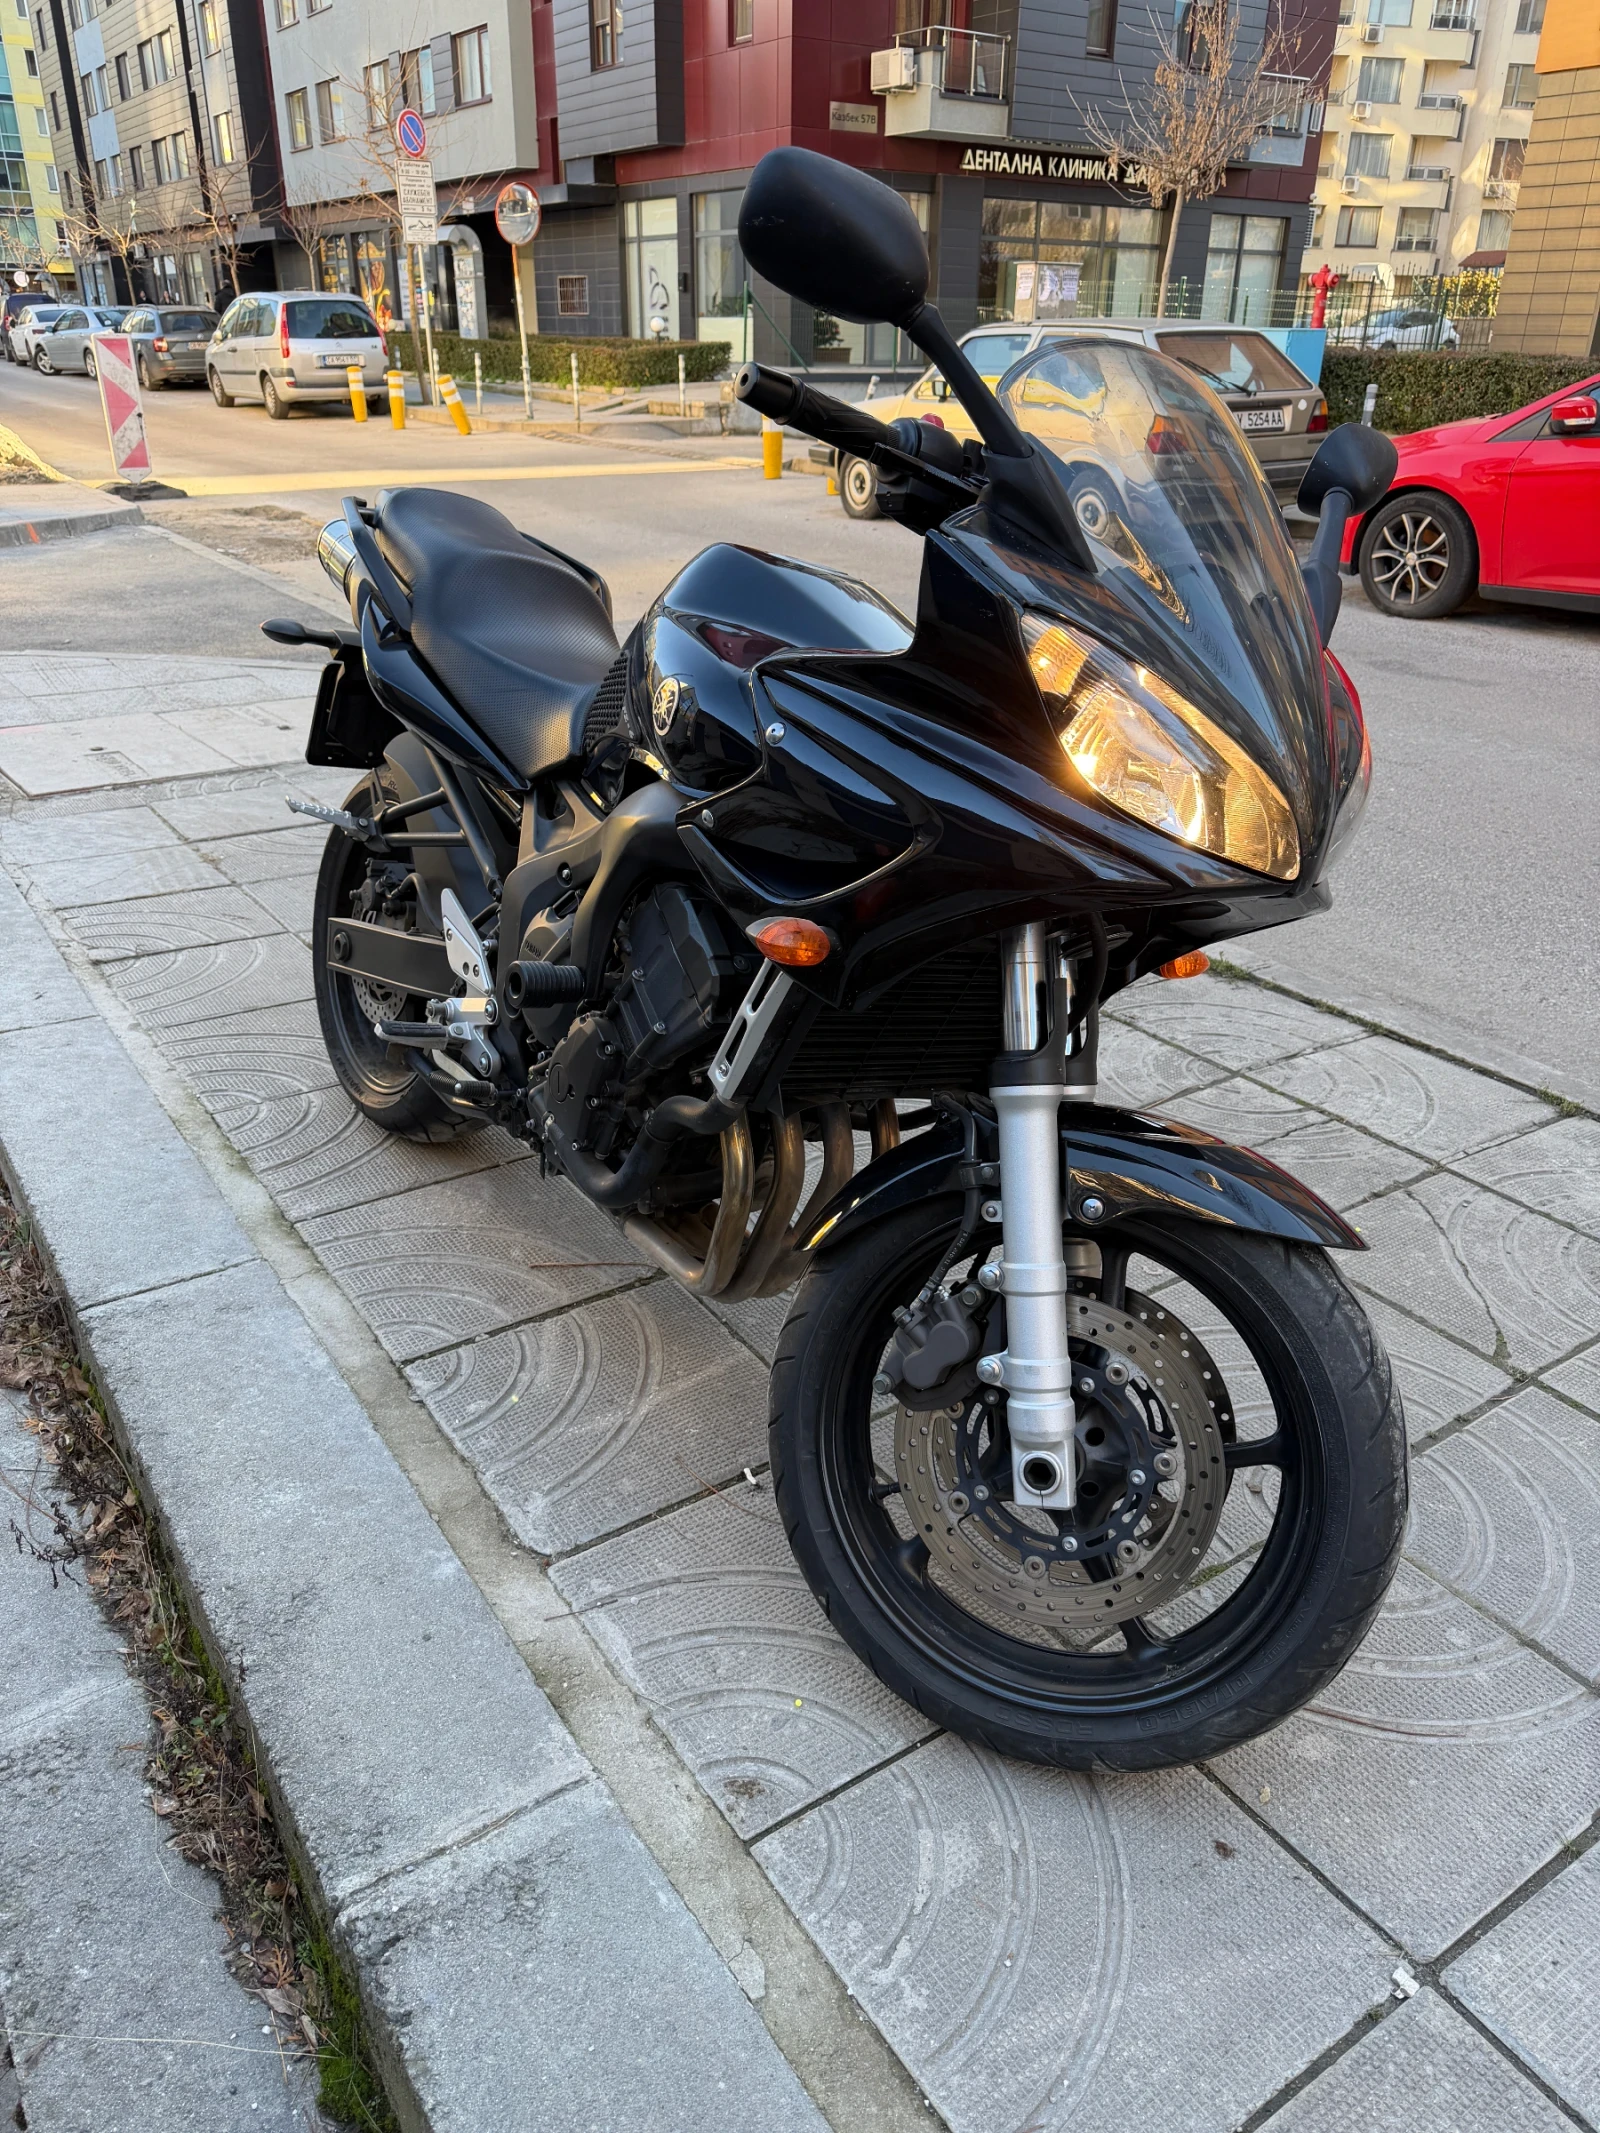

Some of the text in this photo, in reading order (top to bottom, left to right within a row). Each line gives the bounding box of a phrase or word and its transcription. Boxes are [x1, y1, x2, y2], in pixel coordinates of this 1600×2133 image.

[832, 111, 859, 123] Казбек
[960, 149, 1043, 176] ДЕНТАЛНА
[1048, 156, 1118, 182] КЛИНИКА
[1248, 411, 1269, 427] 5254
[1271, 411, 1283, 426] AA
[1138, 1671, 1253, 1732] DIABLO
